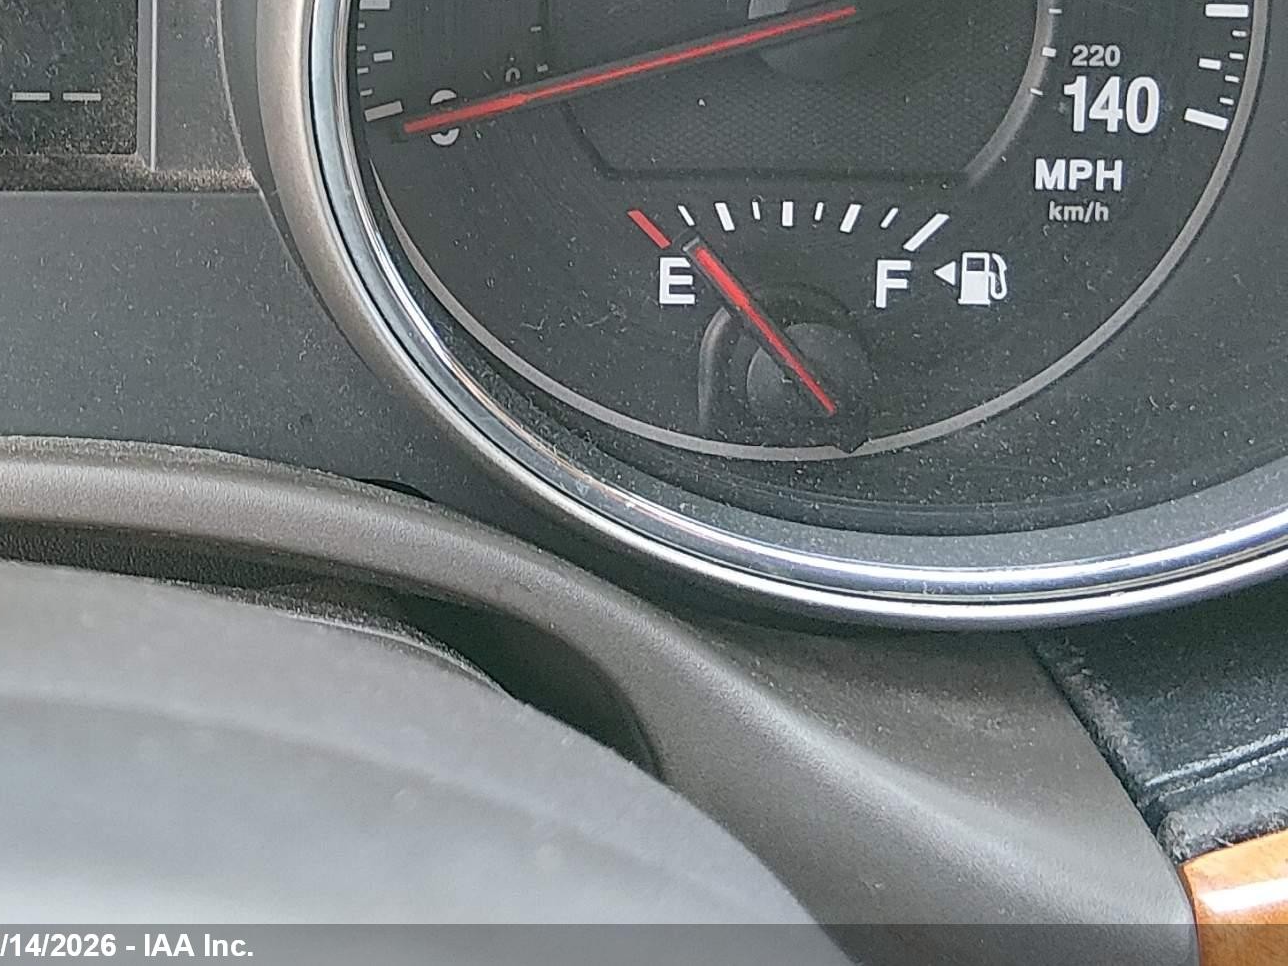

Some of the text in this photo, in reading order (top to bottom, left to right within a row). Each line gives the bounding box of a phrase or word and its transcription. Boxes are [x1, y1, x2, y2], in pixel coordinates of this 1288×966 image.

[1072, 45, 1121, 67] 220
[1063, 76, 1160, 134] 140
[1034, 159, 1124, 192] MPH
[1048, 202, 1110, 223] km/h
[659, 257, 696, 305] E
[875, 260, 912, 309] F
